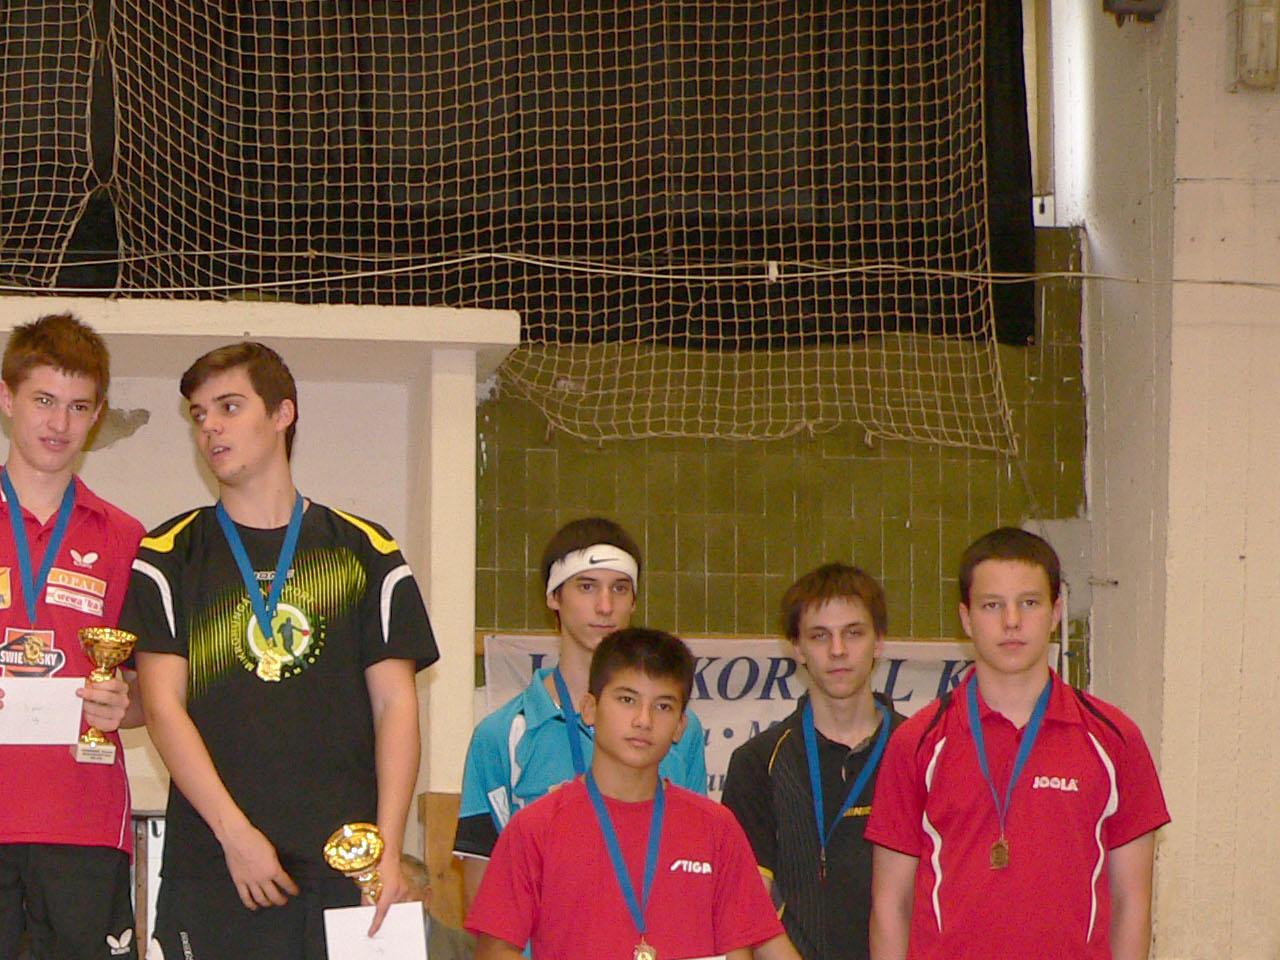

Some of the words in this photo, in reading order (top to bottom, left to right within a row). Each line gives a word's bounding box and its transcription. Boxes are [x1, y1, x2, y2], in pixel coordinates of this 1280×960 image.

[0, 650, 59, 666] SWIESKY
[1032, 775, 1078, 791] JOOLA
[670, 859, 712, 875] STIGA
